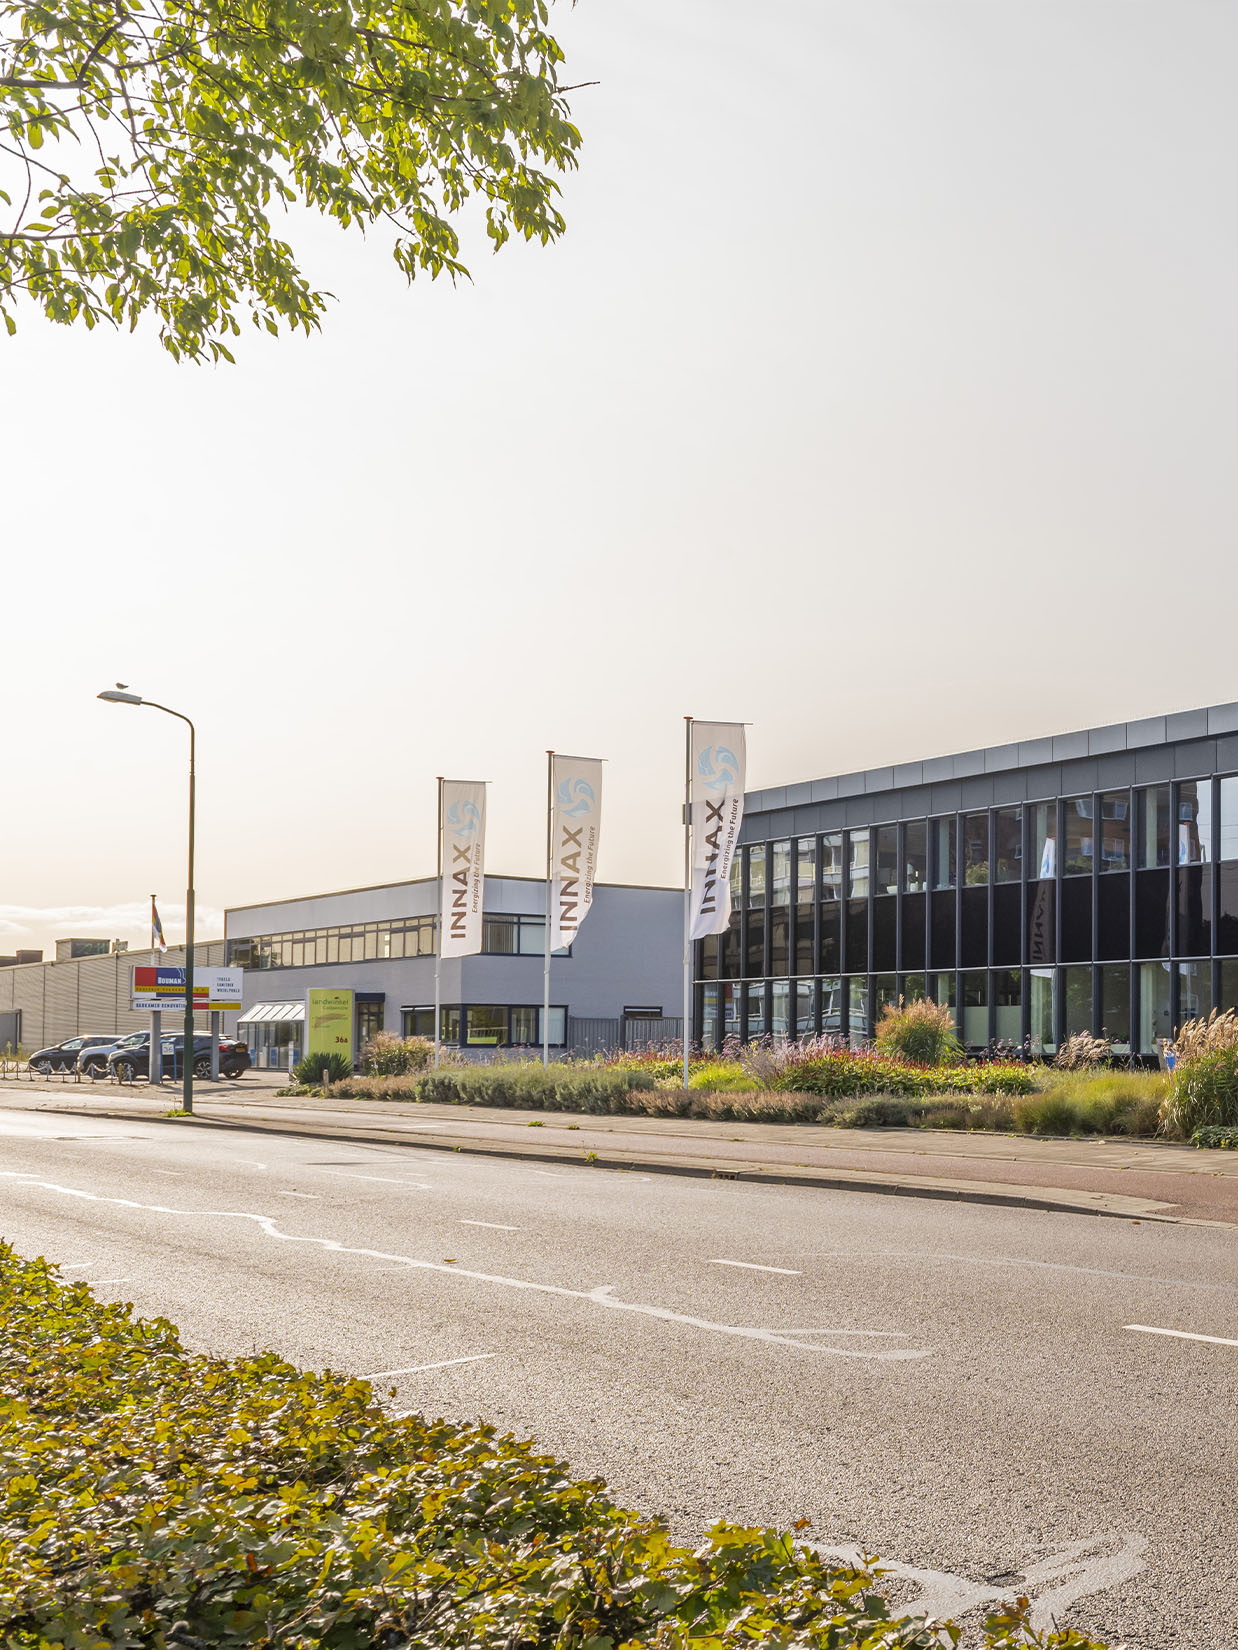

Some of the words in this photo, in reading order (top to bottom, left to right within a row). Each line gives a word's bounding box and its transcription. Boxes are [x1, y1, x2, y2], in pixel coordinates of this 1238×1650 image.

[560, 825, 583, 931] INNAX
[700, 799, 725, 914] INNAX
[721, 840, 734, 879] Energizing
[729, 798, 738, 824] Future
[450, 843, 471, 939] INNAX
[472, 880, 480, 913] Energizing
[584, 867, 593, 904] Energizing
